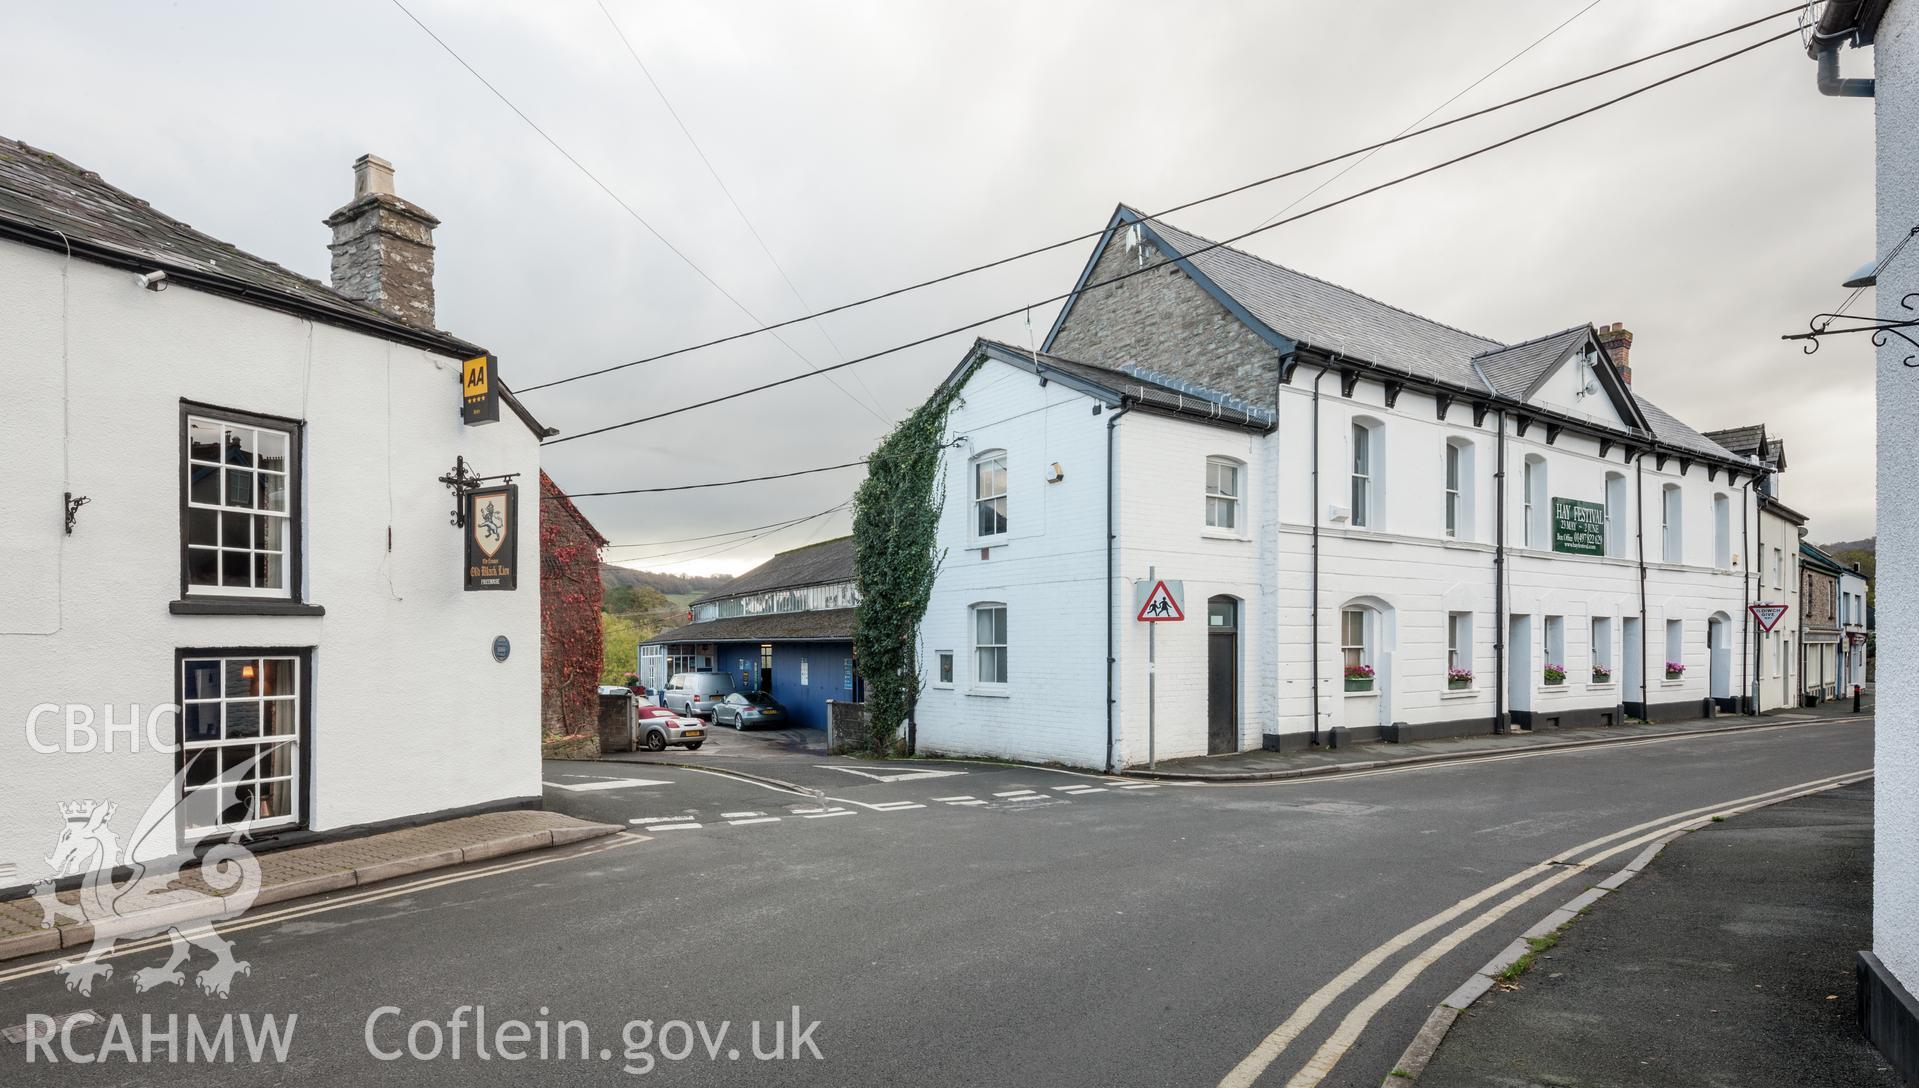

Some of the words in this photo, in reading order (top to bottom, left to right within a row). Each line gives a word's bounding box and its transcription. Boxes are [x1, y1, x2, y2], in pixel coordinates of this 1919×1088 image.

[468, 366, 484, 388] AA
[1556, 503, 1571, 520] HAY
[1573, 506, 1604, 524] FESTIVAL
